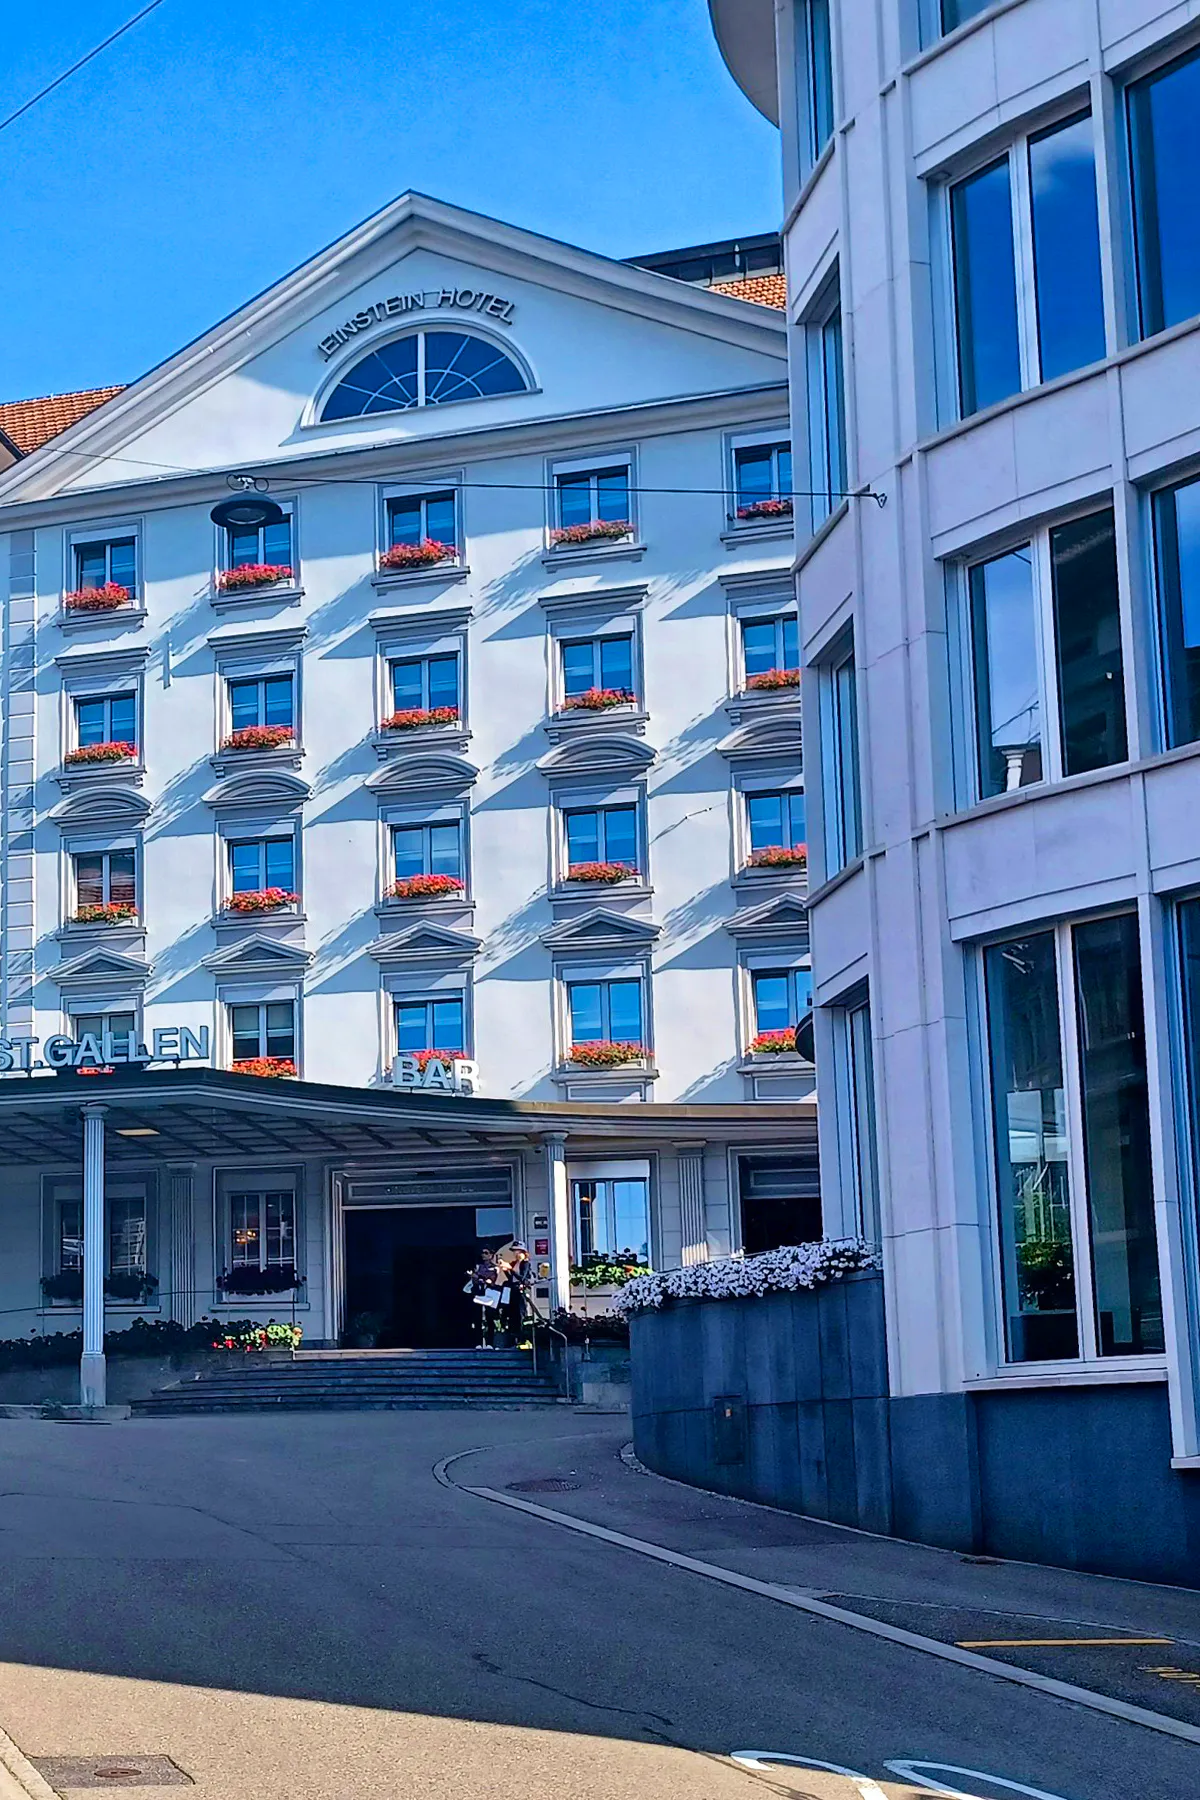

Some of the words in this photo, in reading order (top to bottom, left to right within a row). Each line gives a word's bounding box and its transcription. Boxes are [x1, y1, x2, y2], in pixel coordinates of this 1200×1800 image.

[319, 291, 426, 362] EINSTEIN
[438, 288, 515, 325] HOTEL
[393, 1056, 481, 1094] BAR
